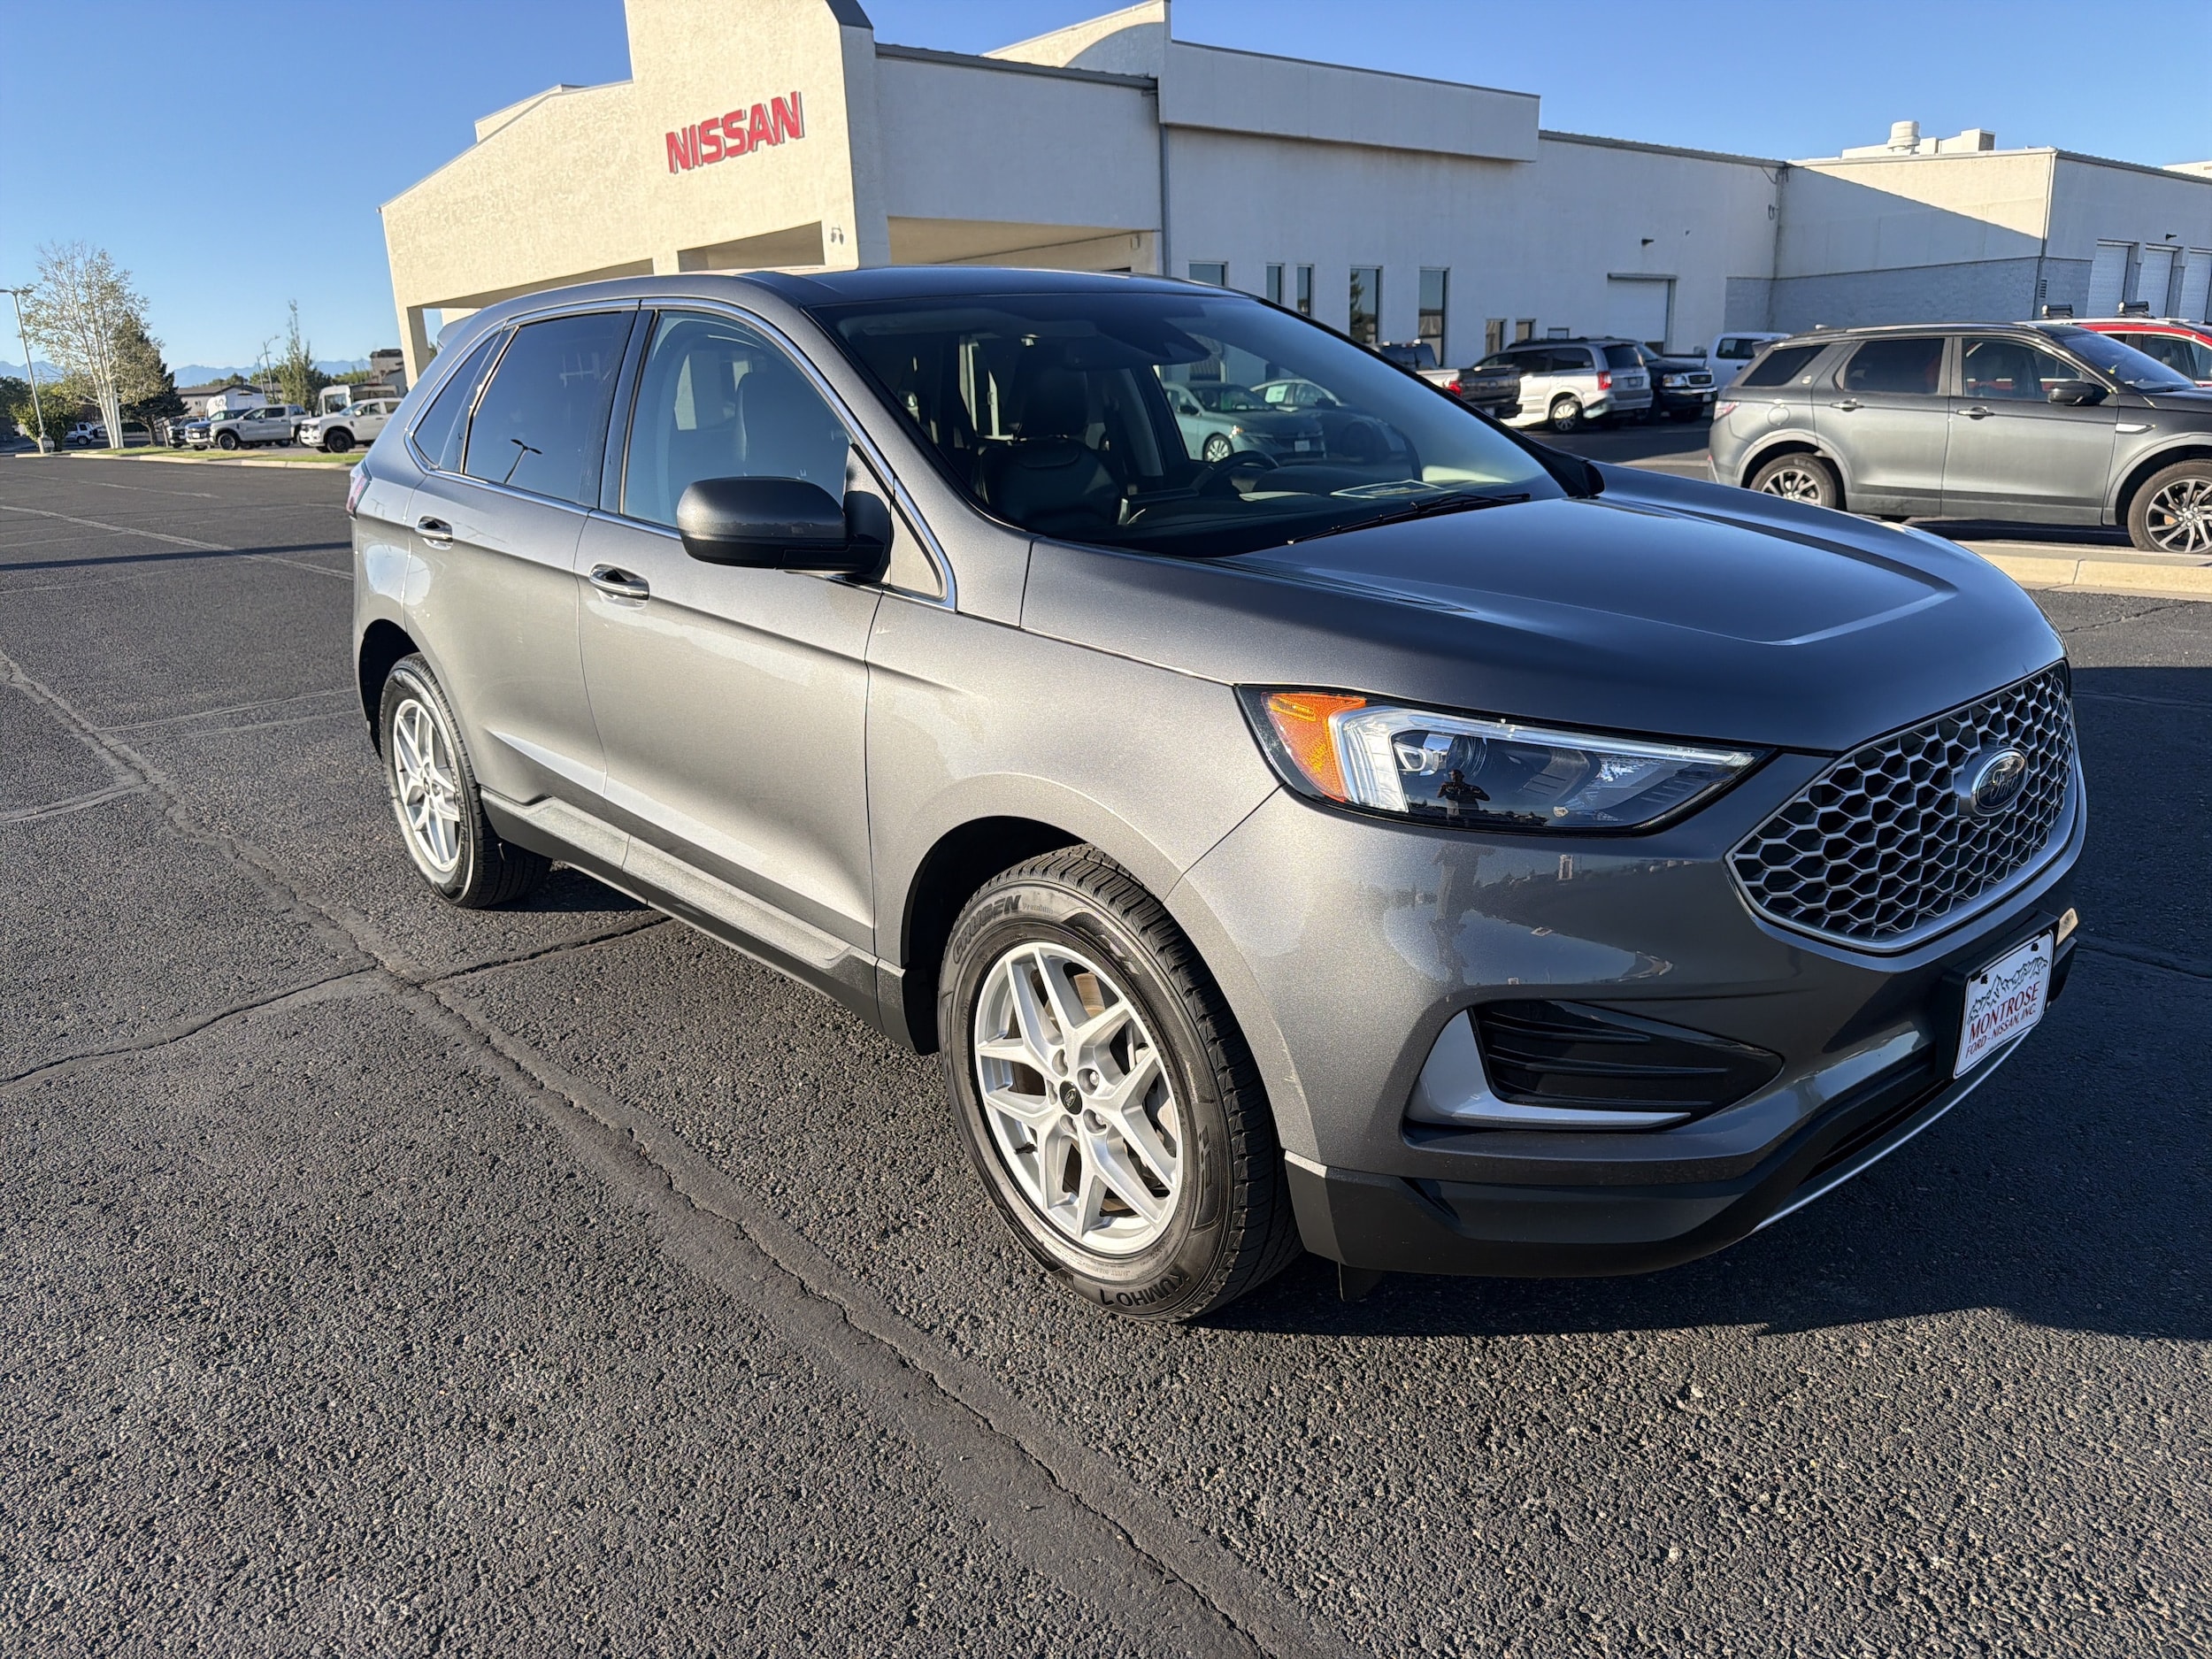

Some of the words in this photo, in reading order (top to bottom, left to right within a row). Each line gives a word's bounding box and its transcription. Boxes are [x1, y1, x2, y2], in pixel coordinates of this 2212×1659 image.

[665, 90, 804, 174] NISSAN
[953, 895, 1021, 964] CRUGEN
[1969, 980, 2040, 1043] MONTROSE
[1965, 1034, 1987, 1059] FORD
[1116, 1263, 1190, 1307] KUMHO
